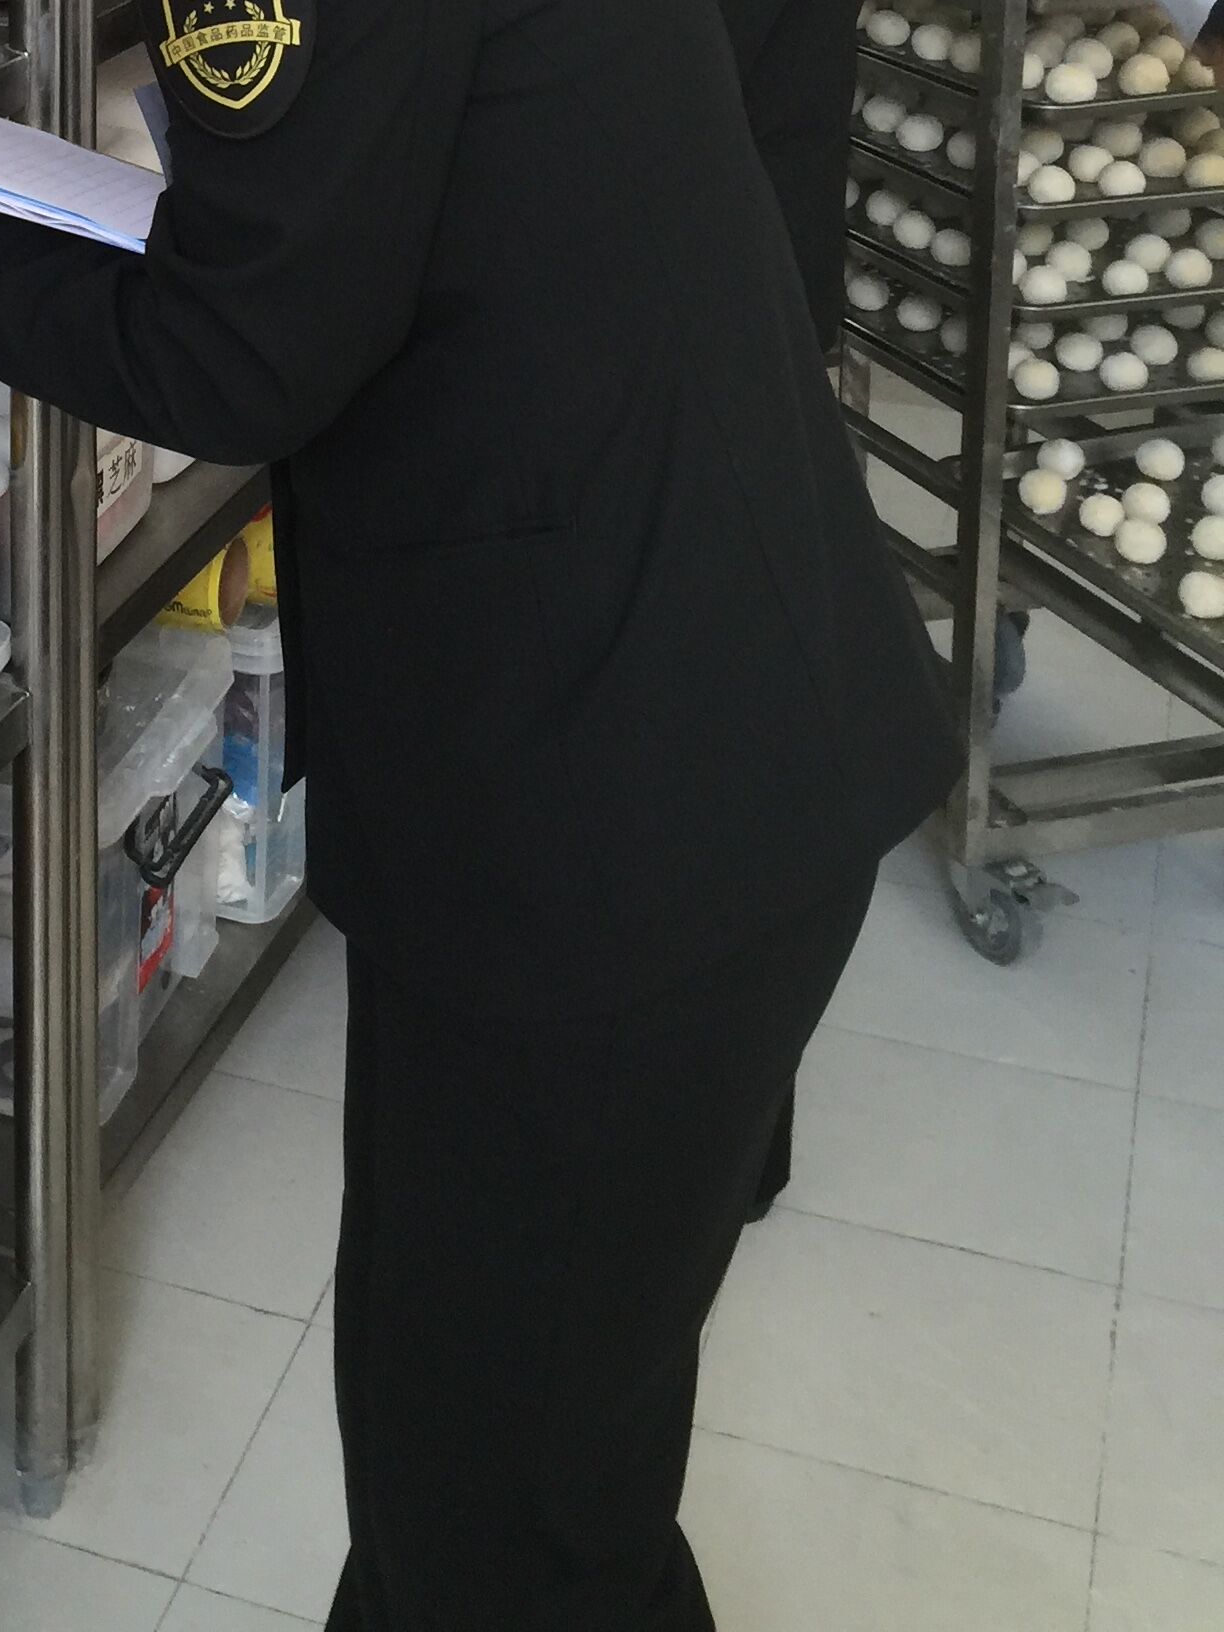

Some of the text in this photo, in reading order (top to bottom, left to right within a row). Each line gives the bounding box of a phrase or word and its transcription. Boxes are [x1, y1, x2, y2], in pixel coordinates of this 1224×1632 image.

[171, 24, 288, 58] 中国食品药品监管
